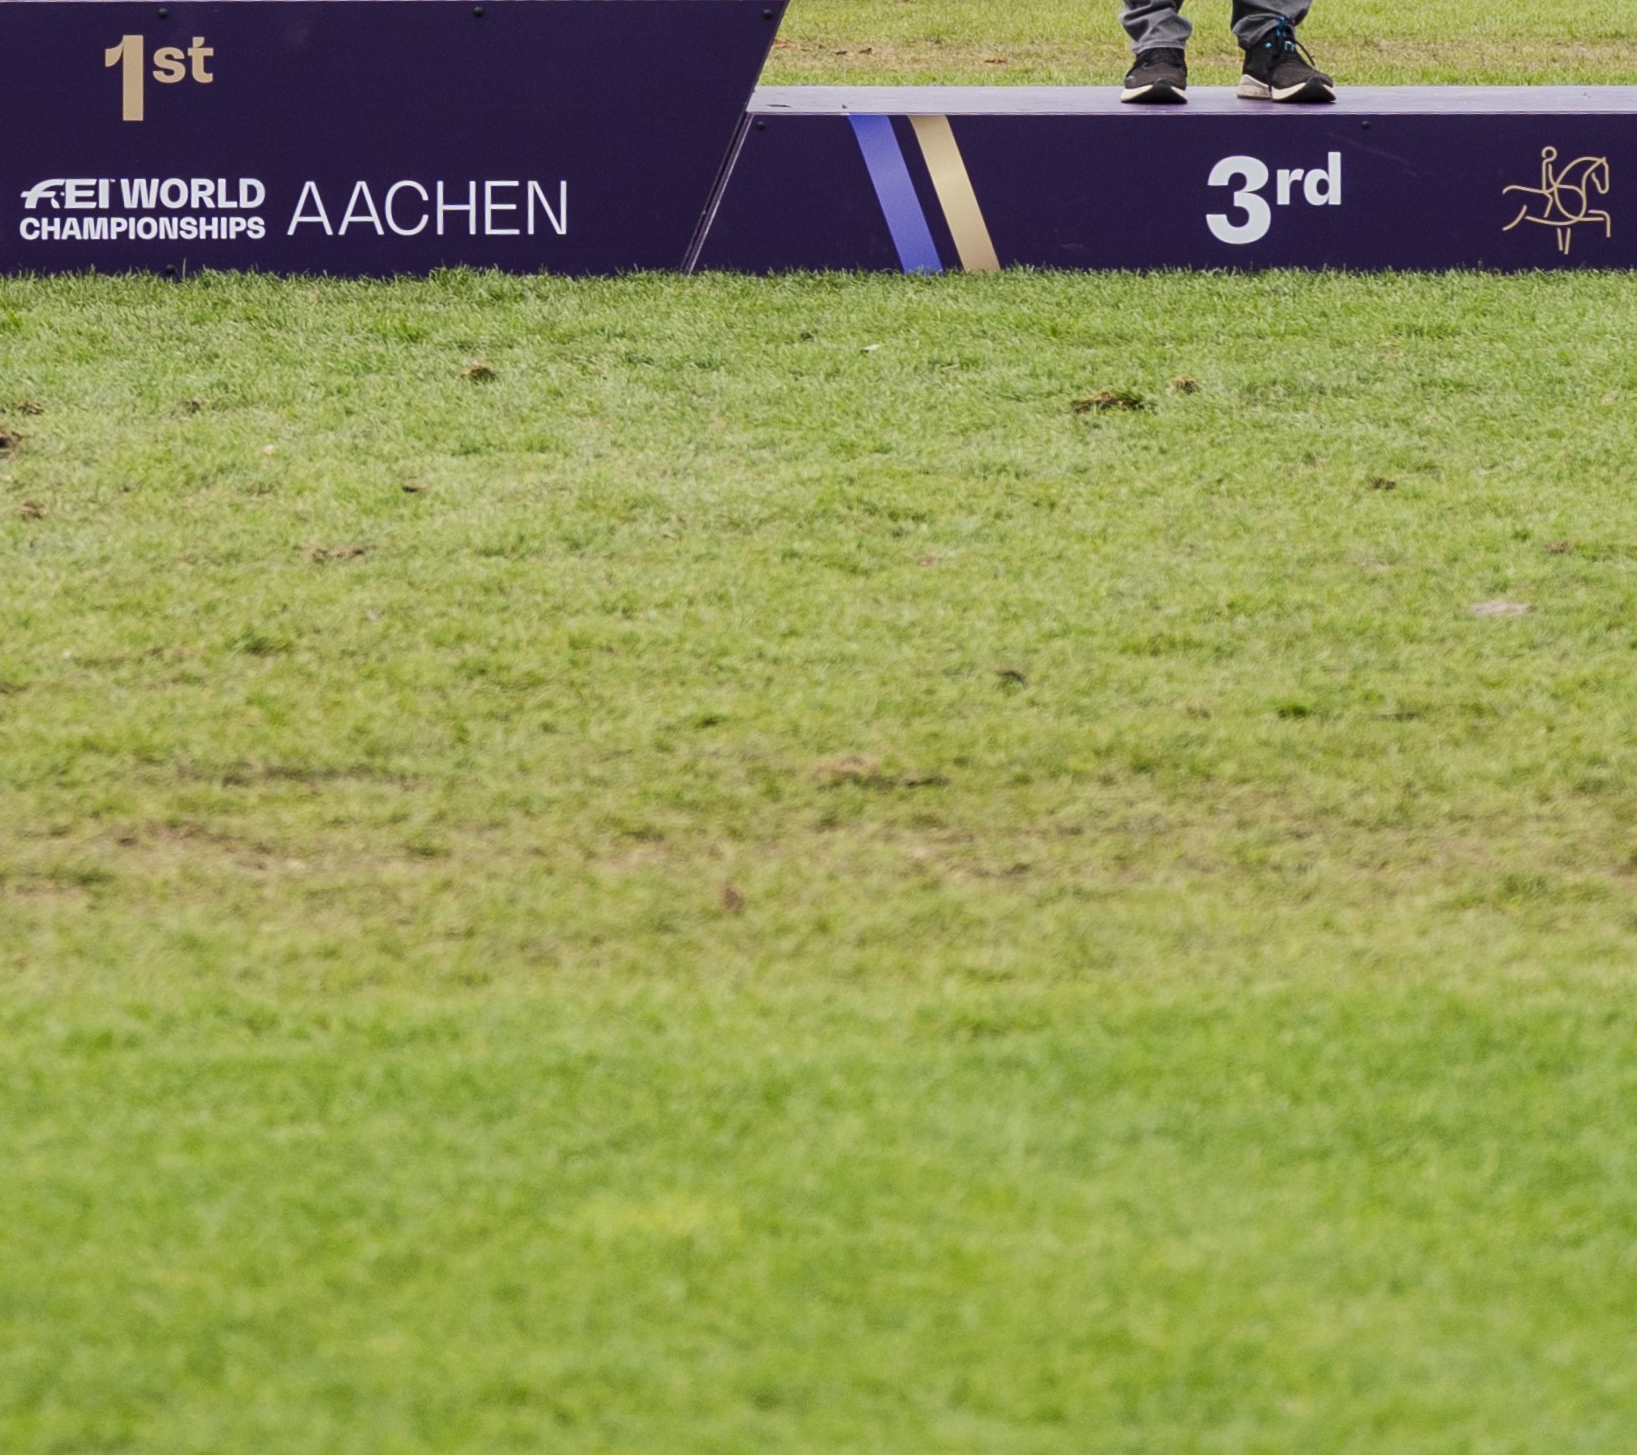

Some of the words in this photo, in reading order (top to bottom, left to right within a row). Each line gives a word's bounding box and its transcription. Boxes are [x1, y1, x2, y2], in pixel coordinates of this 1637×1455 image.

[104, 33, 215, 122] 1st
[19, 177, 113, 211] FEI
[120, 177, 267, 211] WORLD
[287, 180, 568, 237] AACHEN
[1205, 150, 1343, 246] 3rd
[18, 216, 268, 242] CHAMPIONSHIPS
